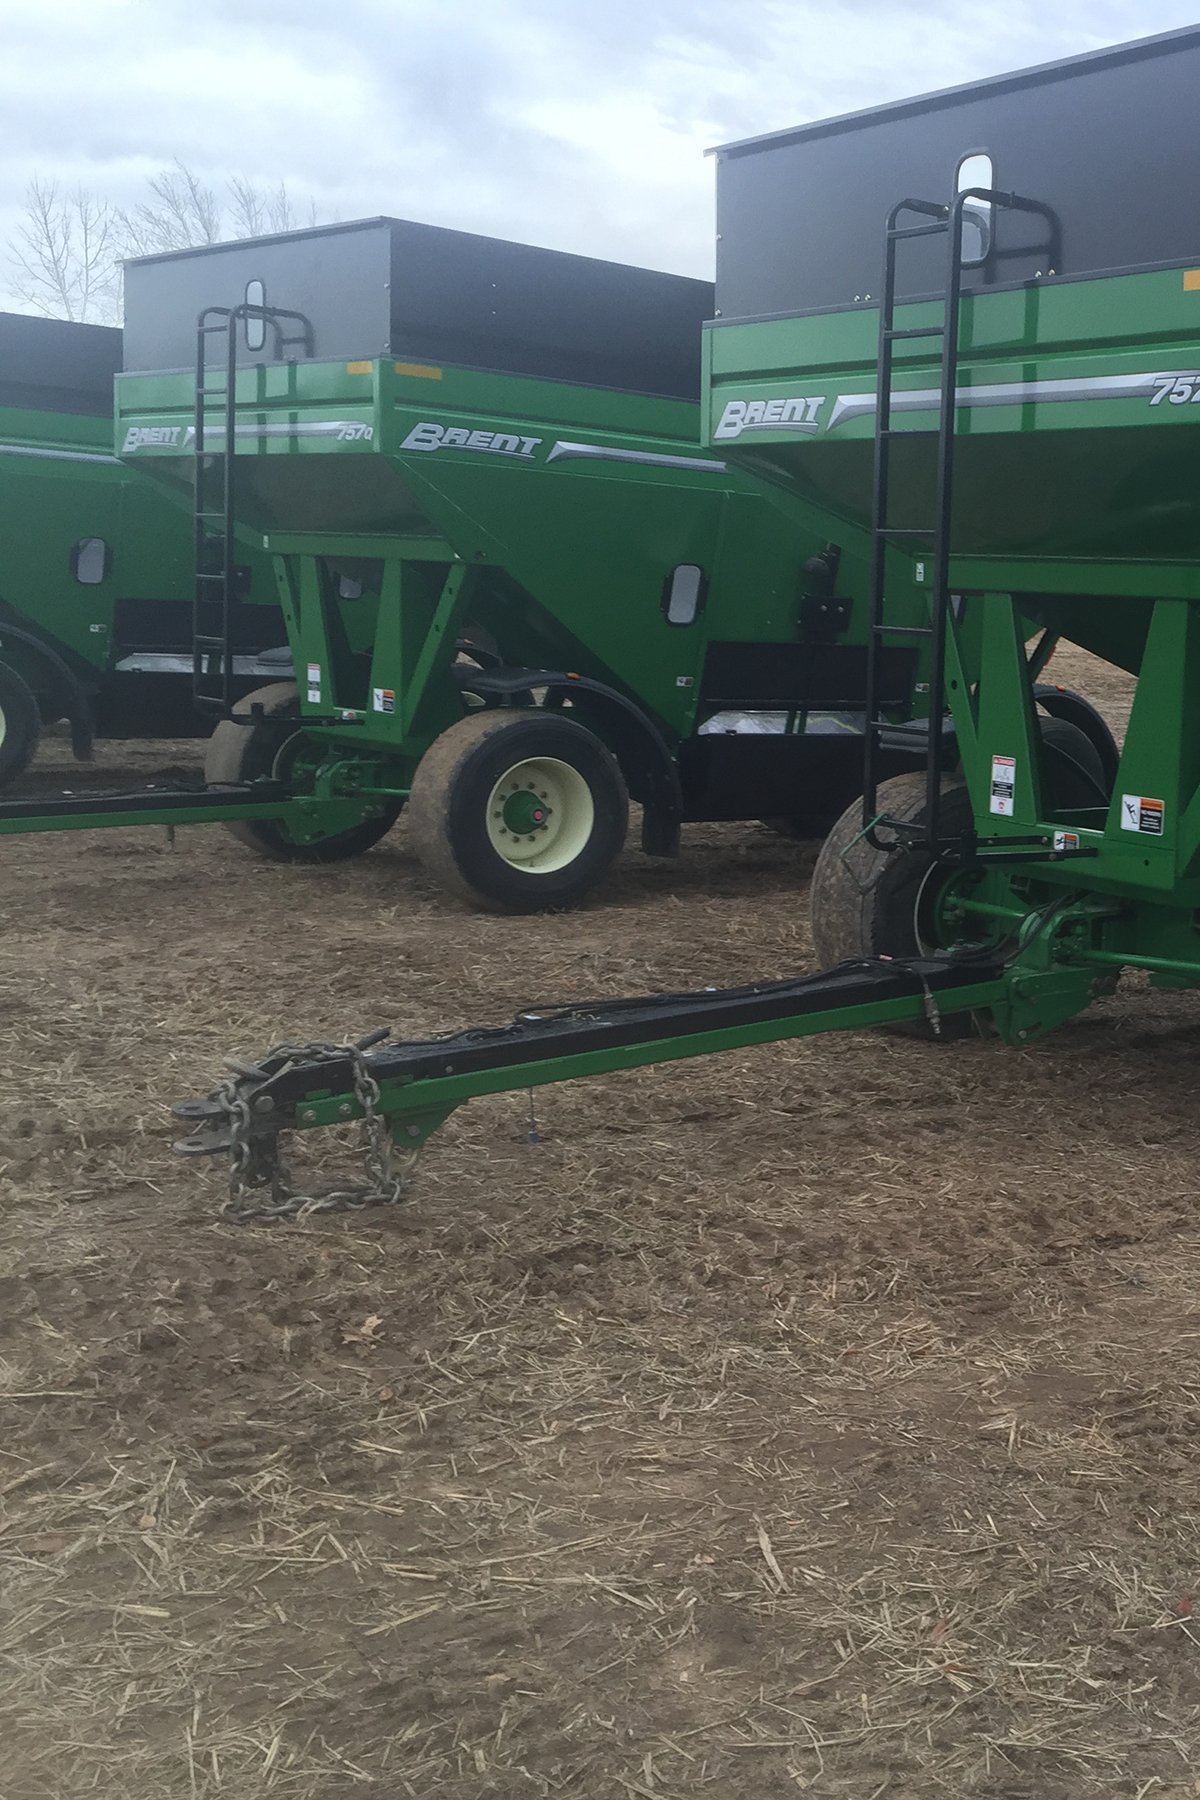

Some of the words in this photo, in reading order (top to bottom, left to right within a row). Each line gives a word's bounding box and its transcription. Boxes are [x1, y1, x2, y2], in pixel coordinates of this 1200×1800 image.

[713, 396, 826, 439] BRENT
[122, 427, 181, 452] BRENT
[336, 423, 374, 441] 757Q
[400, 422, 543, 454] BRENT
